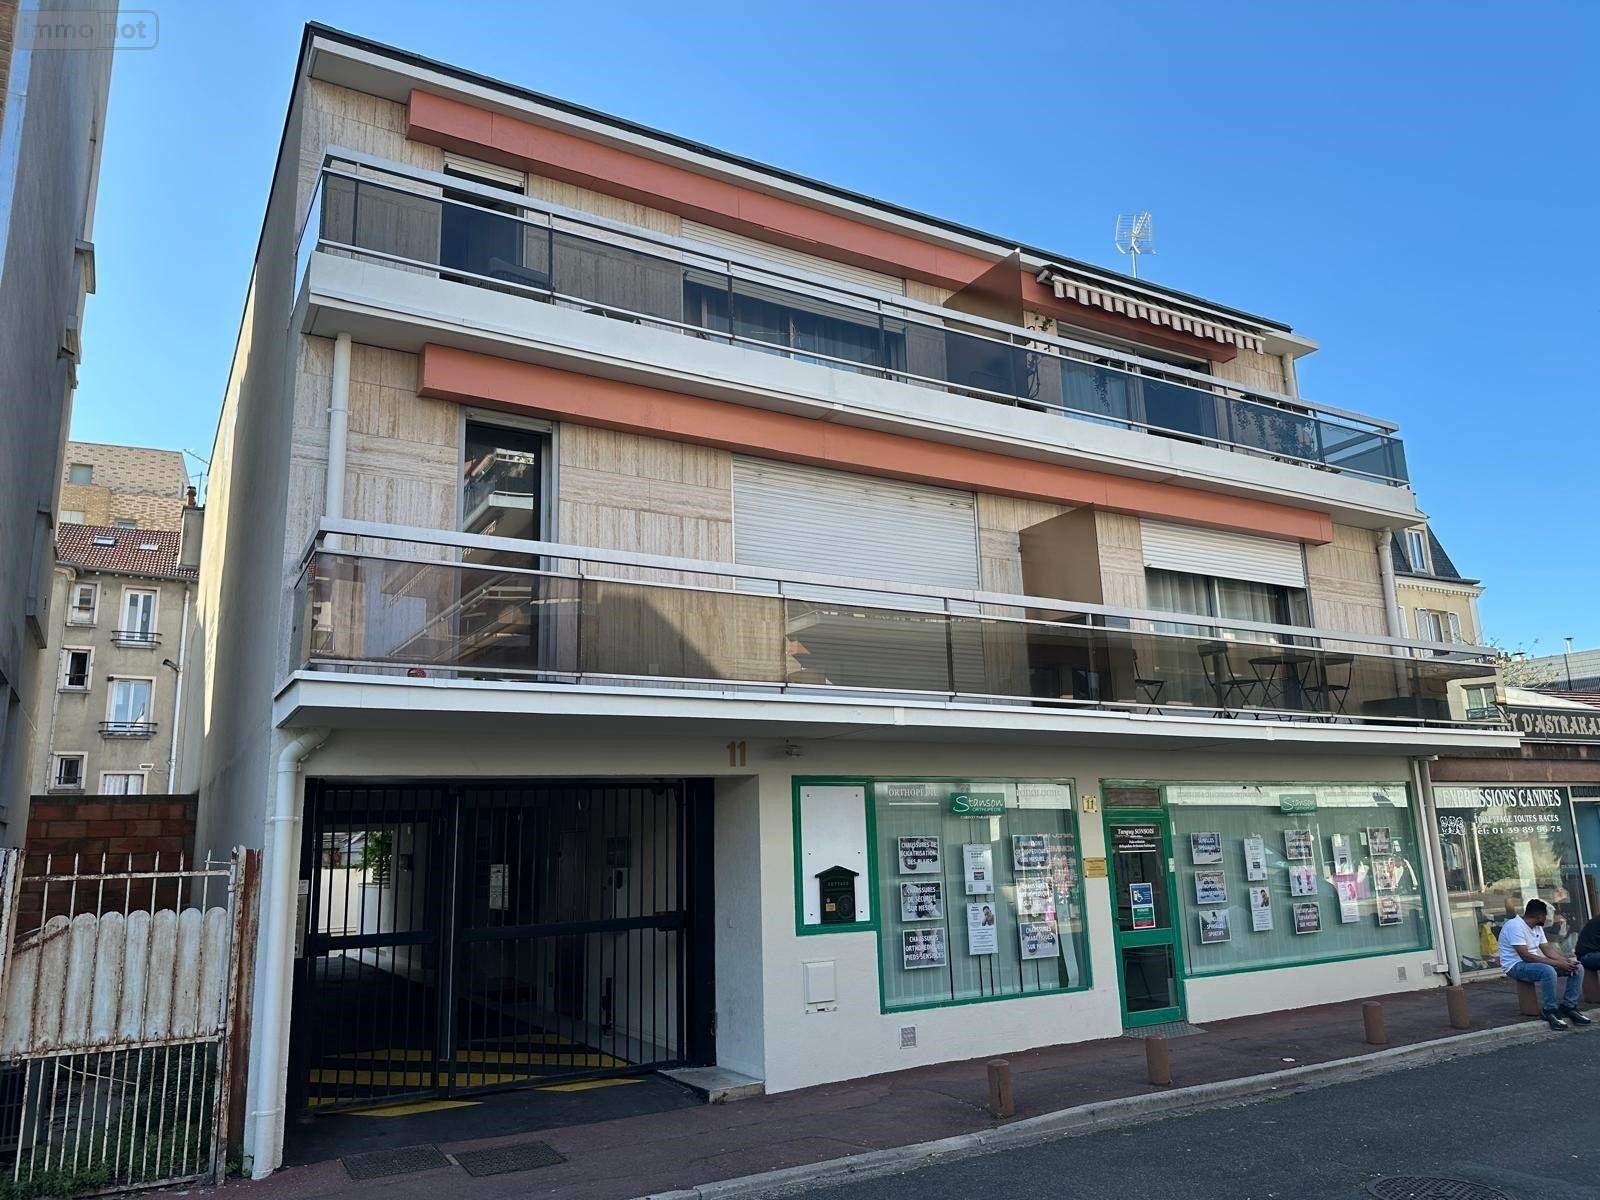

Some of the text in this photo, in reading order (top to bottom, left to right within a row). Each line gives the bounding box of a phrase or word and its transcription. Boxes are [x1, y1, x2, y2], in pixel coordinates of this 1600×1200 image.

[1521, 713, 1600, 736] D'ASTRAKA
[726, 741, 747, 767] 11
[1443, 788, 1516, 807] EXPRESSIONS
[1518, 788, 1562, 807] CANINES
[1513, 814, 1538, 823] TOUTES
[1539, 814, 1560, 822] RACES
[1507, 826, 1520, 834] 39
